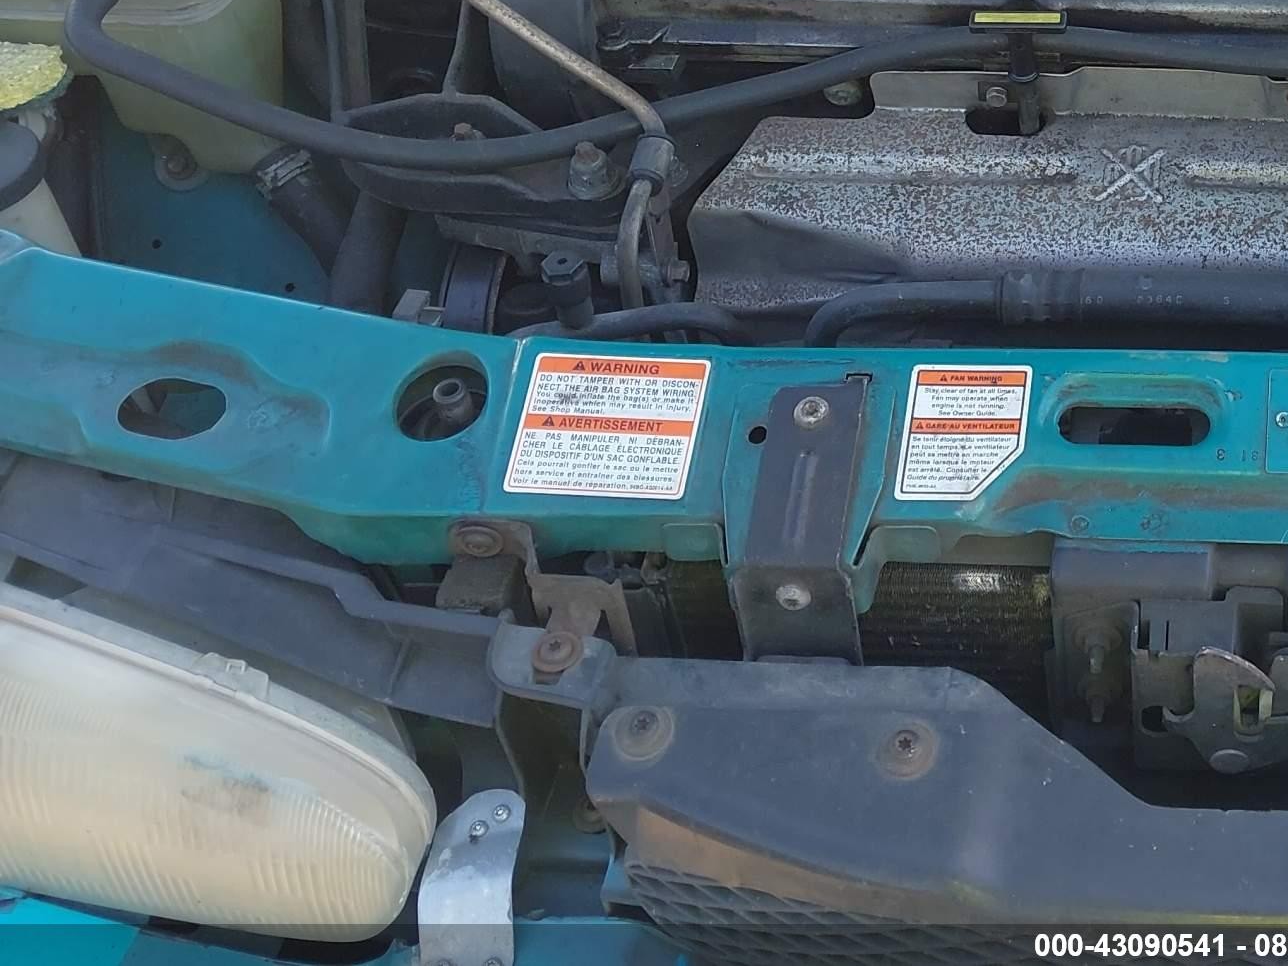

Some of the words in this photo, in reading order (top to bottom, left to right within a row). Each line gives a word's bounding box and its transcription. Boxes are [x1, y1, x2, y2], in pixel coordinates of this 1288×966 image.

[591, 361, 661, 374] WARNING
[540, 374, 552, 382] DO
[557, 375, 574, 383] NOT
[580, 376, 614, 385] TAMPER
[619, 378, 640, 386] WITH
[645, 379, 658, 387] OR
[662, 379, 699, 388] DISCON-
[537, 383, 560, 391] NECT
[602, 386, 620, 394] BAG
[624, 387, 658, 396] SYSTEM
[624, 395, 648, 403] bag(s)
[550, 406, 570, 414] Shop
[559, 417, 663, 432] AVERTISSEMENT
[546, 432, 561, 440] PAS
[523, 441, 546, 449] CHER
[552, 442, 563, 450] LE
[535, 450, 581, 460] DISPOSITIF
[584, 453, 603, 461] D'UN
[607, 454, 624, 462] SAC
[537, 460, 569, 468] pourrait
[572, 462, 600, 470] gonfler
